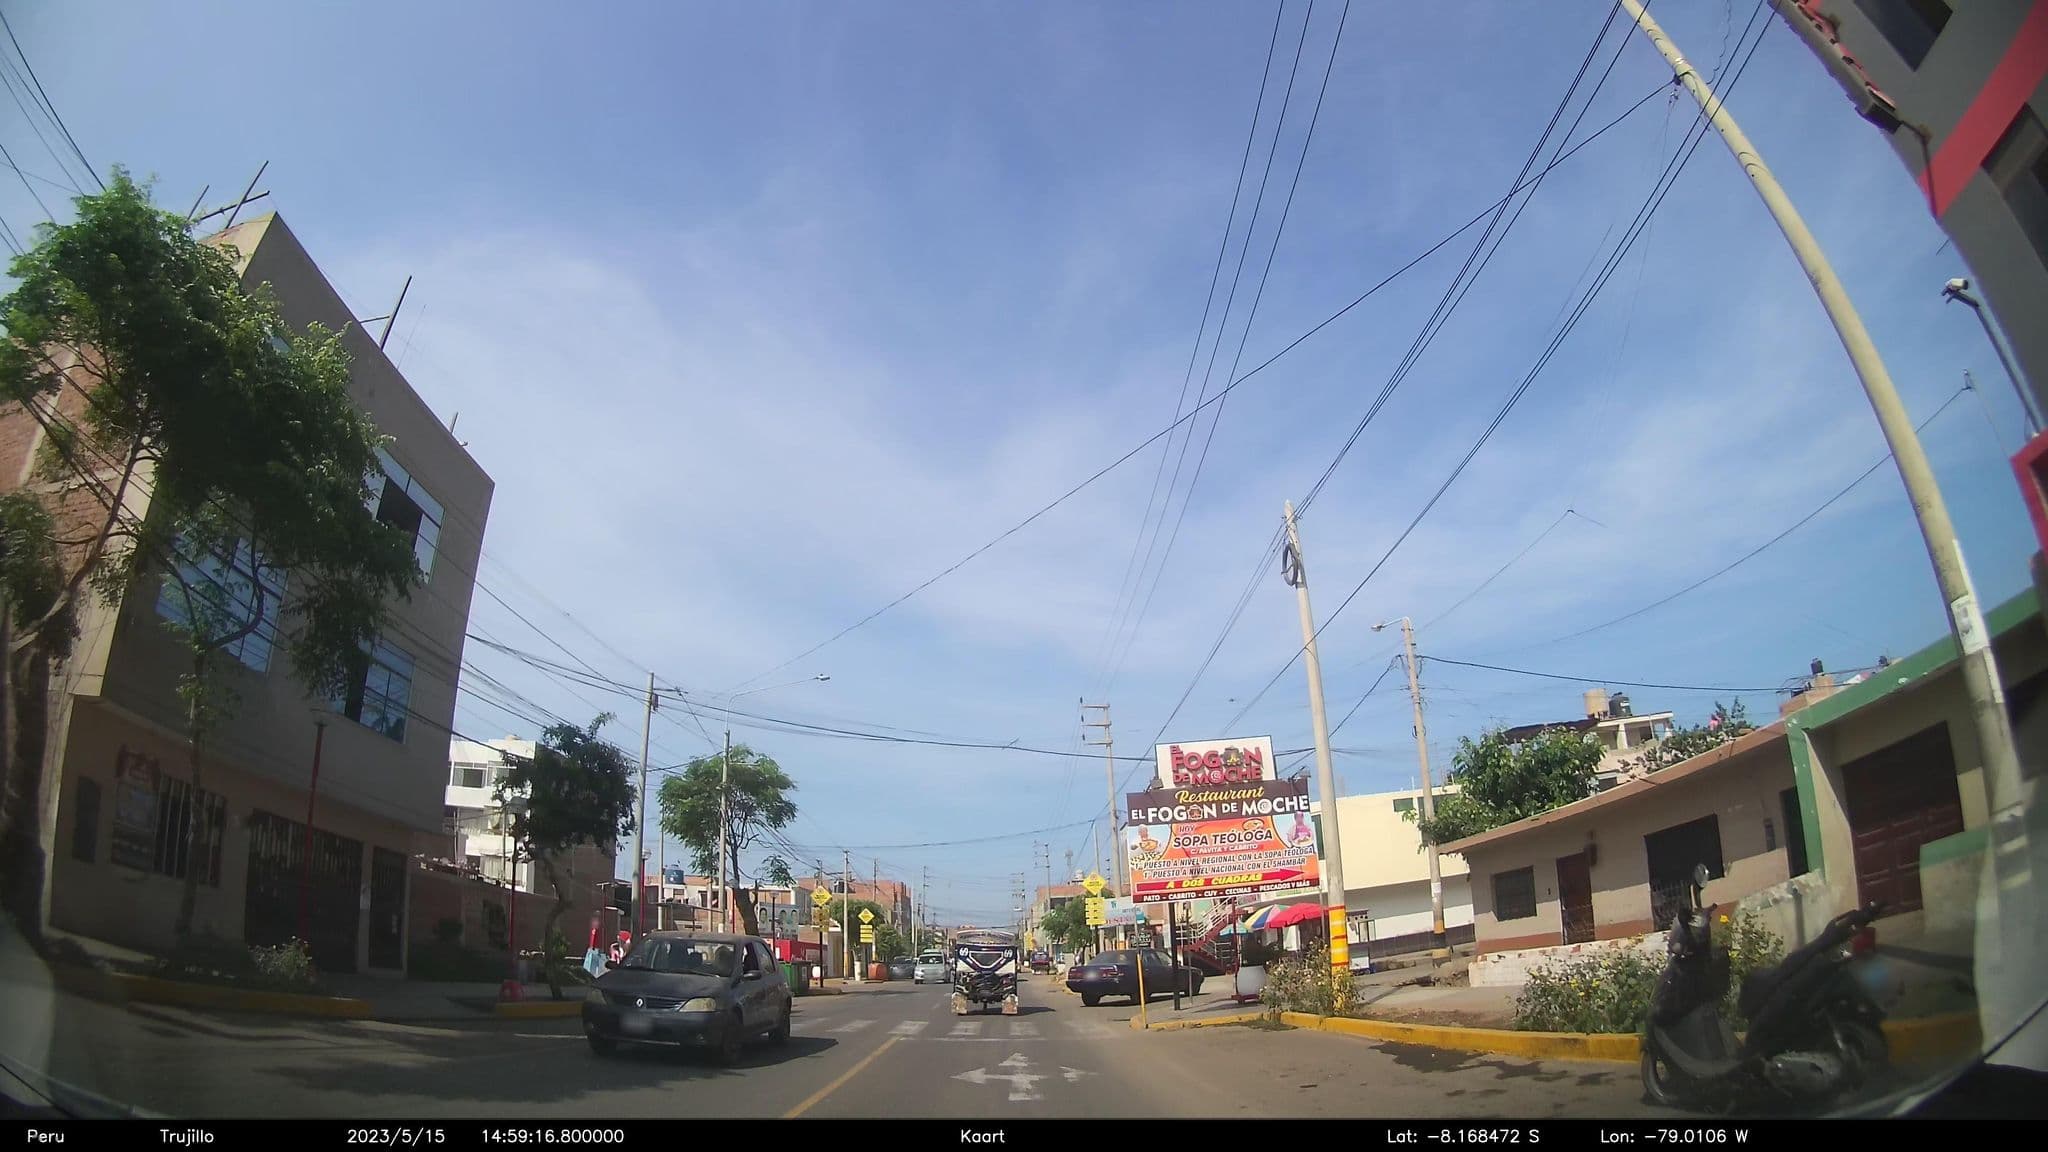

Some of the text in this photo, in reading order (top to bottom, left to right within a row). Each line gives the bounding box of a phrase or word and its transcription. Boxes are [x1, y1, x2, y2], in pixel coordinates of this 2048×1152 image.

[1173, 766, 1263, 785] DE MOCHE
[1175, 786, 1265, 804] Restaurant
[1132, 808, 1146, 820] EL
[1222, 802, 1238, 814] DE
[1242, 795, 1309, 817] MOCHE
[1173, 829, 1273, 848] SOPA TEÓLOGA
[1144, 860, 1171, 869] PUESTO
[1180, 858, 1200, 867] NIVEL
[1202, 855, 1236, 865] REGIONAL
[1238, 853, 1252, 862] CON
[1264, 851, 1282, 859] SOPA
[1153, 869, 1180, 878] PUESTO
[1189, 867, 1209, 876] NIVEL
[1211, 864, 1245, 874] NACIONAL
[1247, 862, 1261, 870] CON
[1263, 861, 1271, 869] EL
[1166, 873, 1263, 889] A DOS CUADRAS
[1143, 894, 1161, 902] PATO
[1168, 891, 1197, 900] CABRITO
[1204, 889, 1218, 897] CUY
